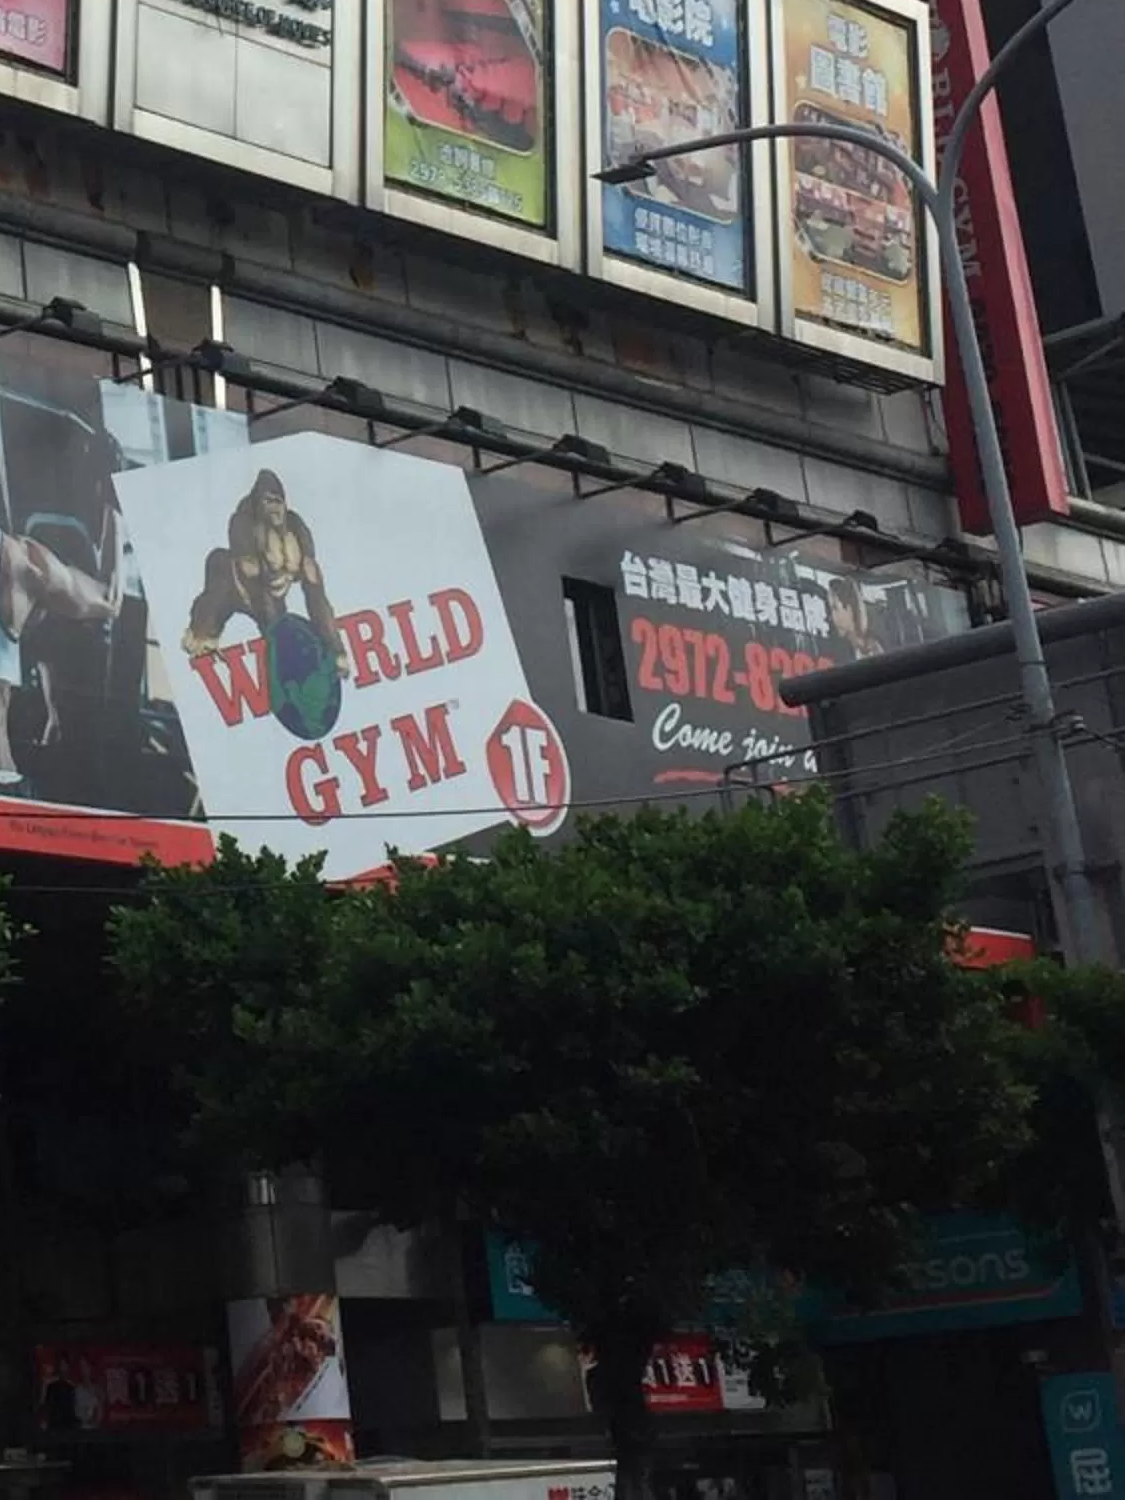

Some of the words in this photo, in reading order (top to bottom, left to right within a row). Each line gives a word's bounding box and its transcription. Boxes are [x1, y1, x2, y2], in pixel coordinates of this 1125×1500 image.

[620, 550, 831, 637] 台灣最大健身品牌
[285, 702, 467, 825] GYM
[511, 724, 551, 808] 1F
[653, 703, 733, 754] Come
